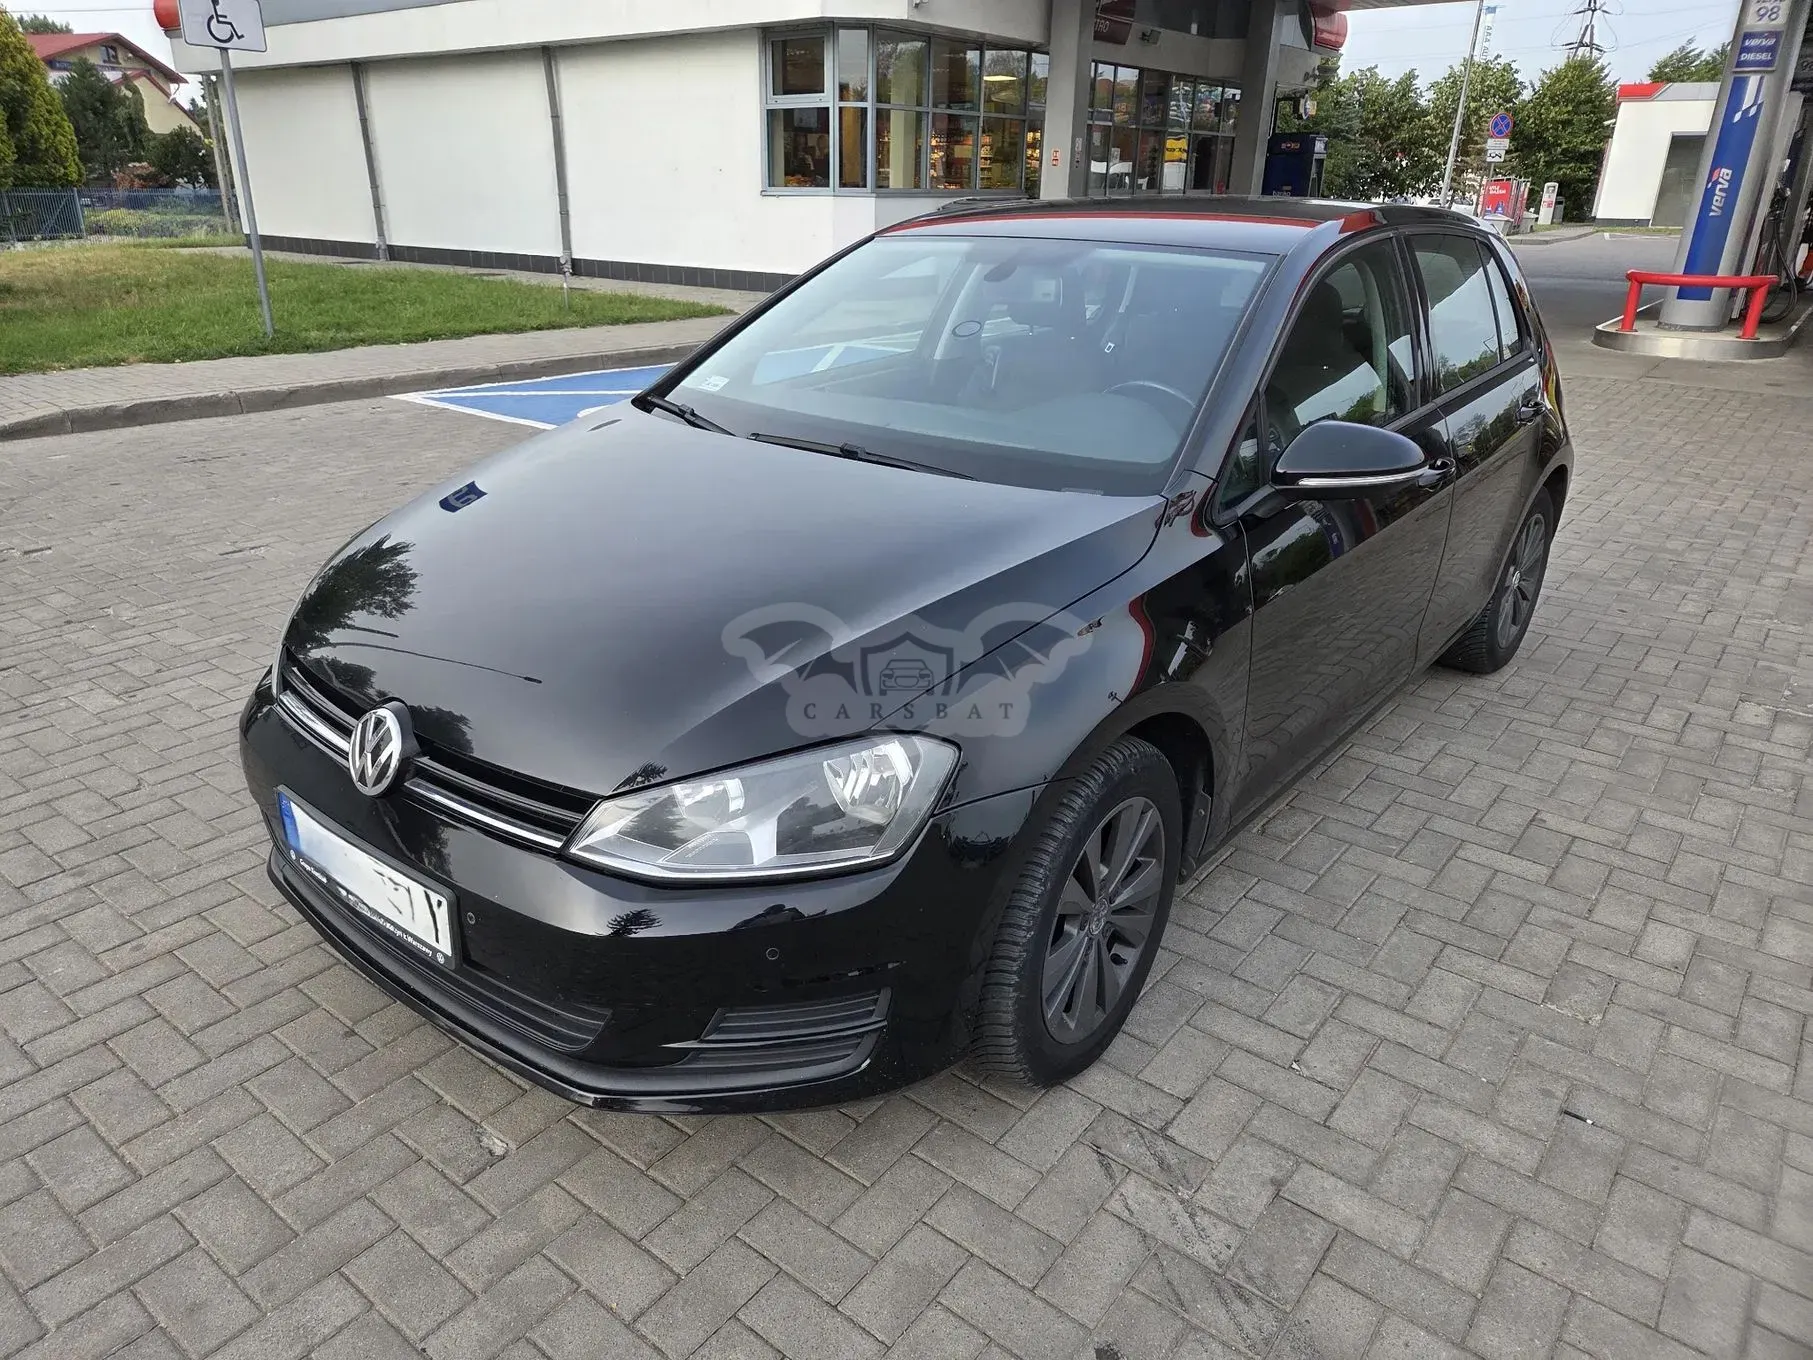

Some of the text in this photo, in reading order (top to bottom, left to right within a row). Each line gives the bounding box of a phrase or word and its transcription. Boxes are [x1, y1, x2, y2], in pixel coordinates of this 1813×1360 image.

[1756, 5, 1781, 22] 98
[1744, 38, 1777, 47] verva
[1740, 52, 1773, 61] DIESEL
[1708, 167, 1733, 217] verva
